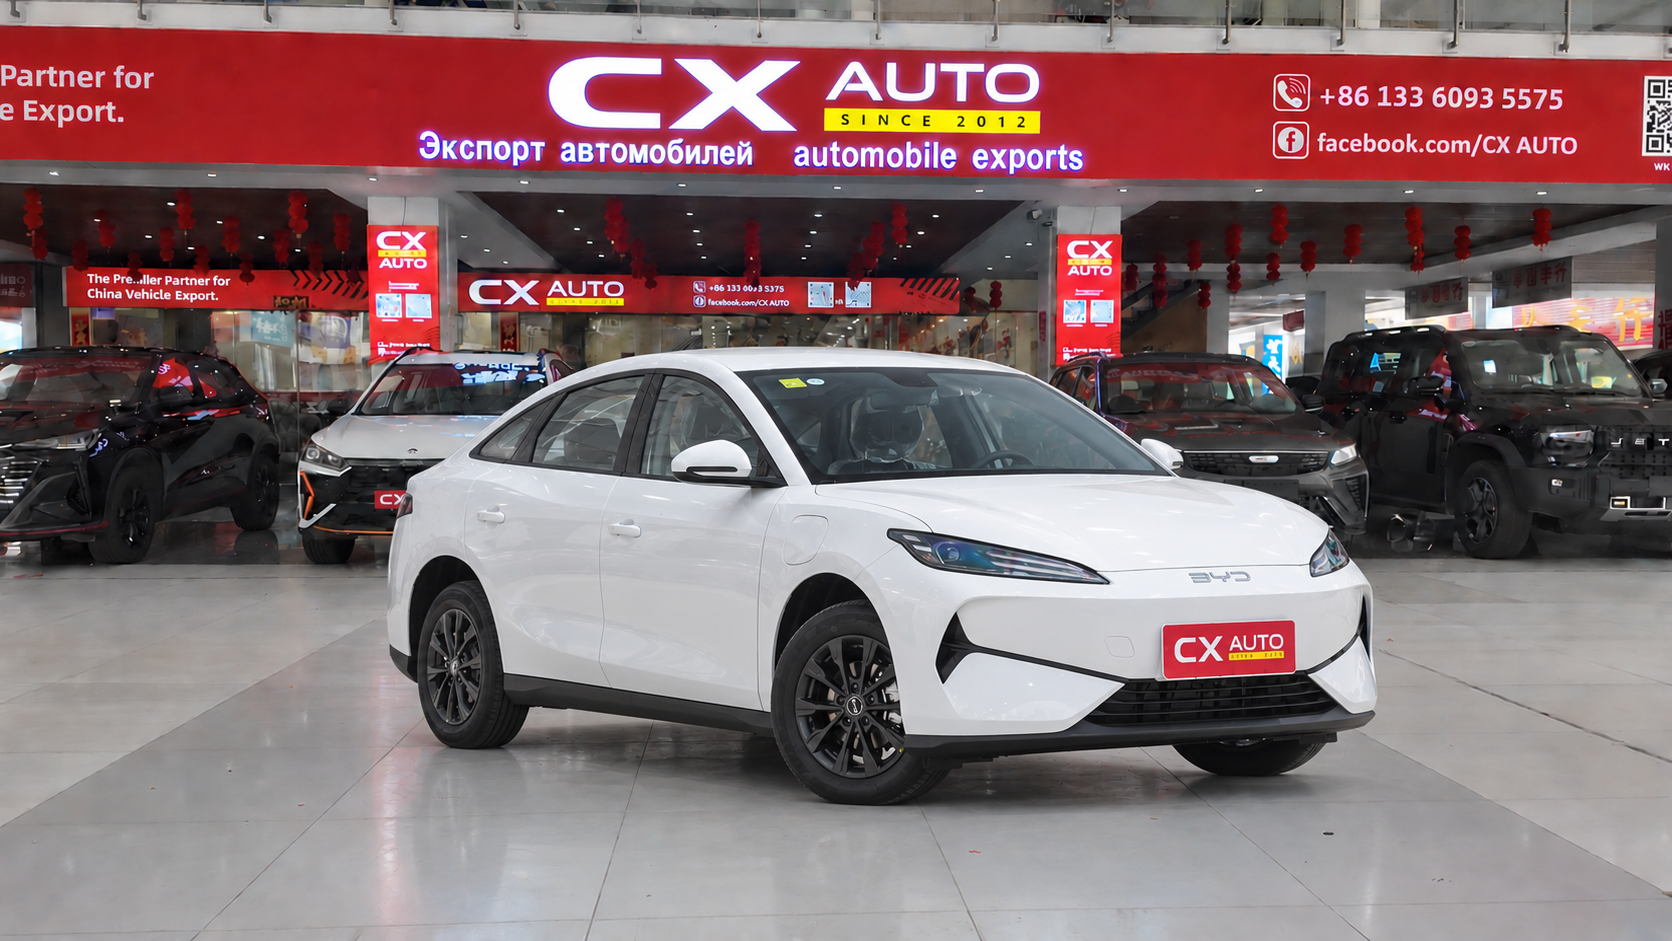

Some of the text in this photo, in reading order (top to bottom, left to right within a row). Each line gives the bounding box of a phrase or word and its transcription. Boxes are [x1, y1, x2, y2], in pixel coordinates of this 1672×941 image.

[1, 65, 155, 89] Partner for
[826, 62, 1040, 103] AUTO
[548, 57, 801, 132] CX
[1321, 86, 1563, 110] +86 133 6093 5575
[24, 100, 124, 128] Export.
[841, 113, 1026, 128] SINCE 2012
[419, 131, 754, 168] Экспорт автомобилей
[1317, 132, 1578, 158] facebook.com/CX AUTO
[793, 141, 1084, 174] automobile exports
[376, 230, 427, 251] CX
[1066, 240, 1113, 259] CX
[379, 257, 428, 269] AUTO
[1067, 265, 1113, 277] AUTO
[86, 273, 110, 284] The
[165, 275, 211, 287] Partner
[212, 274, 231, 288] for
[547, 281, 625, 297] AUTO
[87, 287, 219, 303] China Vehicle Export.
[468, 279, 540, 306] CX
[769, 299, 790, 307] AUTO
[1188, 571, 1252, 584] BYD
[1174, 635, 1224, 664] CX
[1229, 633, 1284, 652] AUTO
